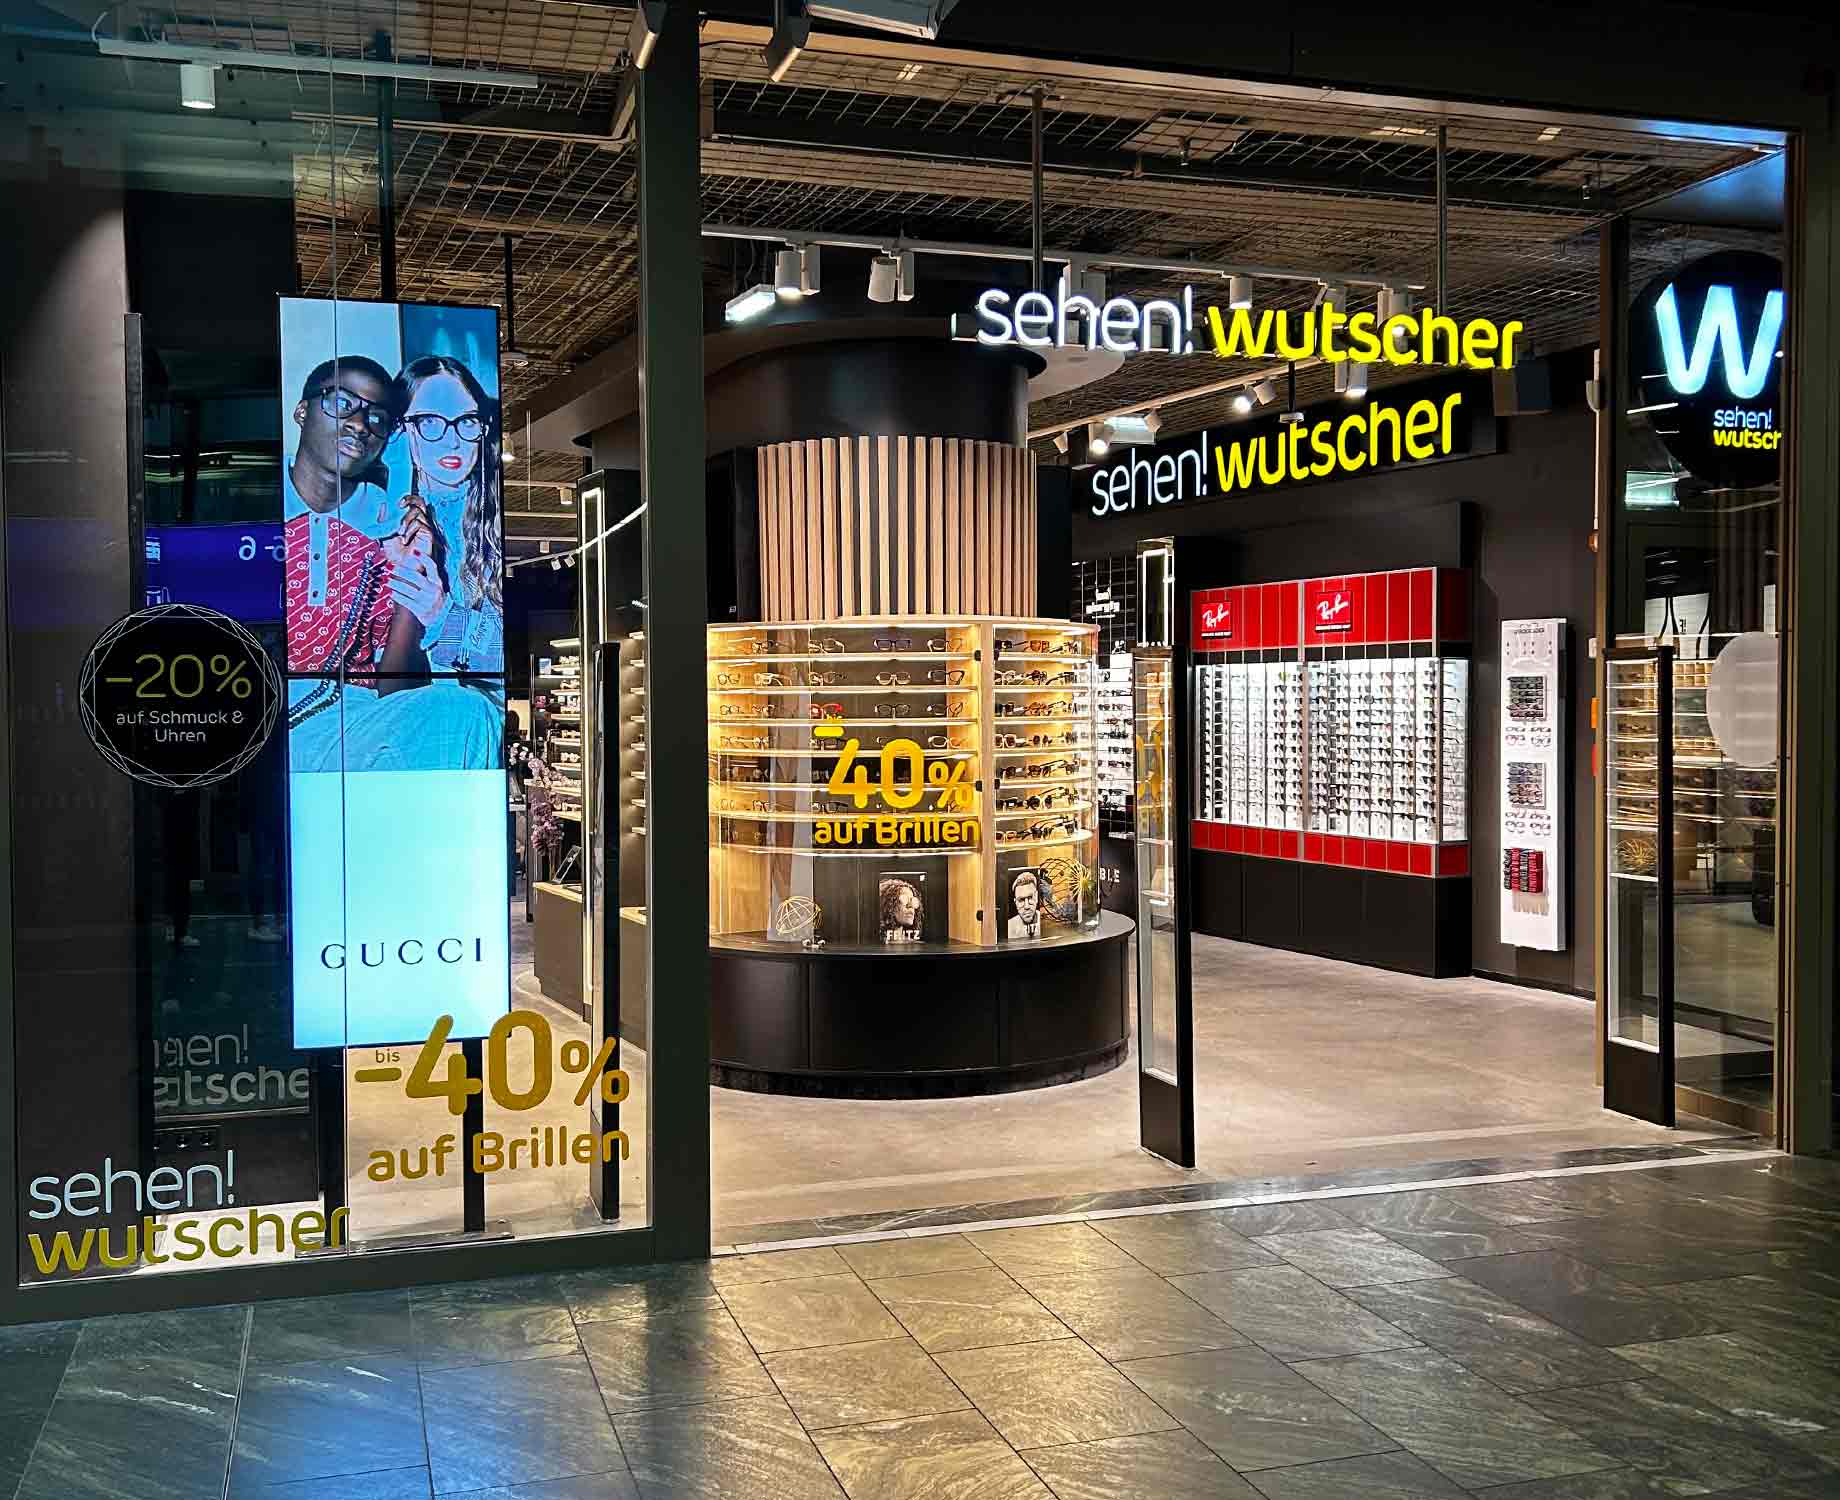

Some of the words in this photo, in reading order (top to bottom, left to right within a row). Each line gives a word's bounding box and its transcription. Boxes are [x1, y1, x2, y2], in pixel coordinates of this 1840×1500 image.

[976, 276, 1194, 355] sehen!
[1206, 302, 1524, 370] wutscher
[1713, 405, 1772, 430] sehen!
[1091, 430, 1209, 517] sehen!
[1214, 391, 1462, 493] wutscher
[105, 653, 252, 698] -20%
[116, 711, 145, 725] auf
[149, 710, 228, 725] Schmuck
[231, 710, 245, 724] &
[154, 729, 207, 743] Uhren
[814, 816, 870, 845] auf
[875, 815, 980, 845] Brillen
[321, 938, 482, 970] GUCCI
[354, 1010, 630, 1116] -40%
[375, 1049, 401, 1063] bis
[367, 1133, 456, 1182] auf
[472, 1125, 630, 1174] Brillen
[28, 1149, 235, 1220] sehen!
[27, 1206, 351, 1275] wutscher
